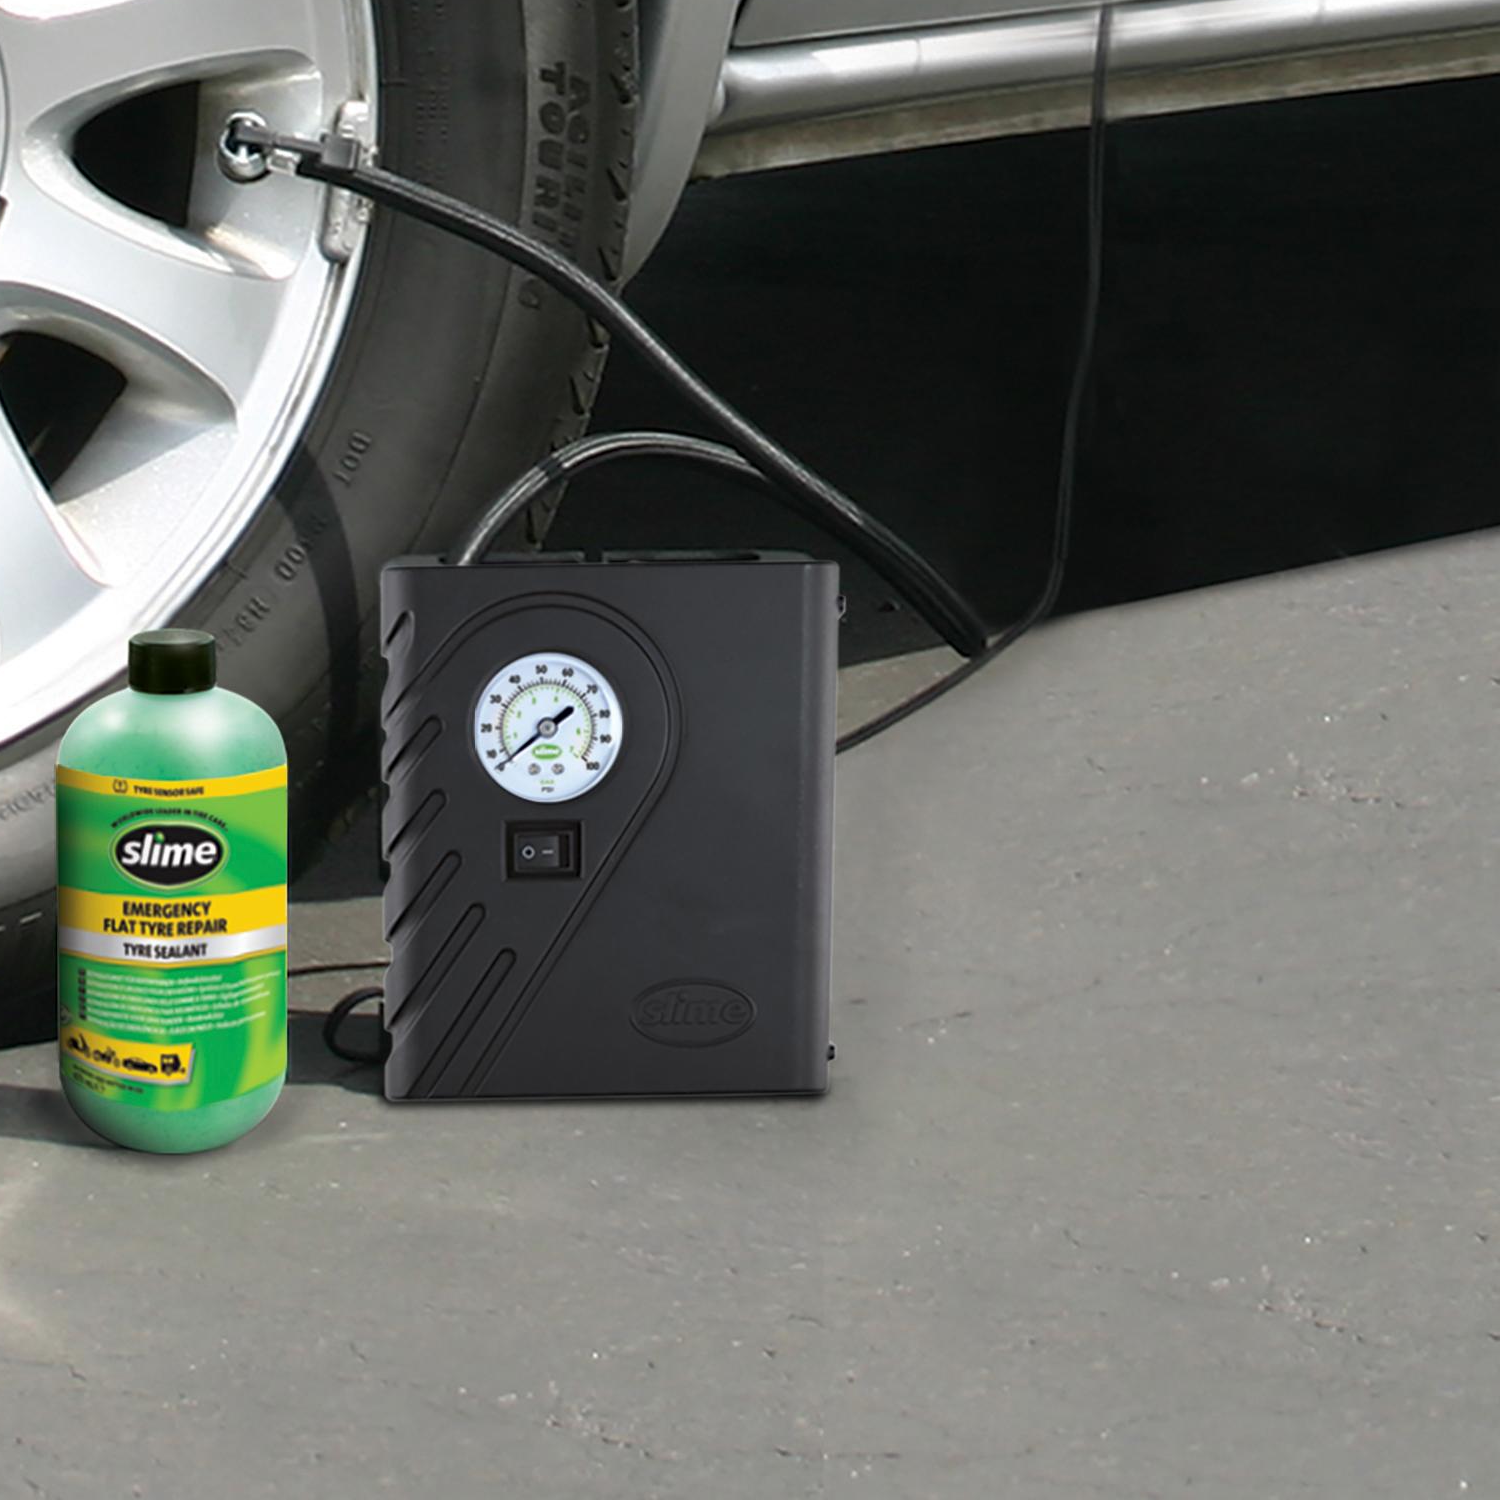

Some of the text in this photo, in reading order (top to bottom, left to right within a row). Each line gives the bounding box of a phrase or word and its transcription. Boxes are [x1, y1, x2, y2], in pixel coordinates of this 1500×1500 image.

[517, 61, 567, 310] TOURIG
[535, 665, 547, 674] 50
[562, 668, 574, 677] 60
[509, 675, 520, 684] 40
[599, 709, 611, 718] 80
[481, 723, 493, 733] 20
[600, 734, 611, 743] 90
[586, 763, 600, 771] 100
[121, 831, 217, 867] slime
[123, 900, 211, 918] EMERGENCY
[103, 918, 227, 937] FLAT TYRE REPAIR
[123, 942, 207, 959] TYRE SEALANT
[638, 989, 748, 1026] slime
